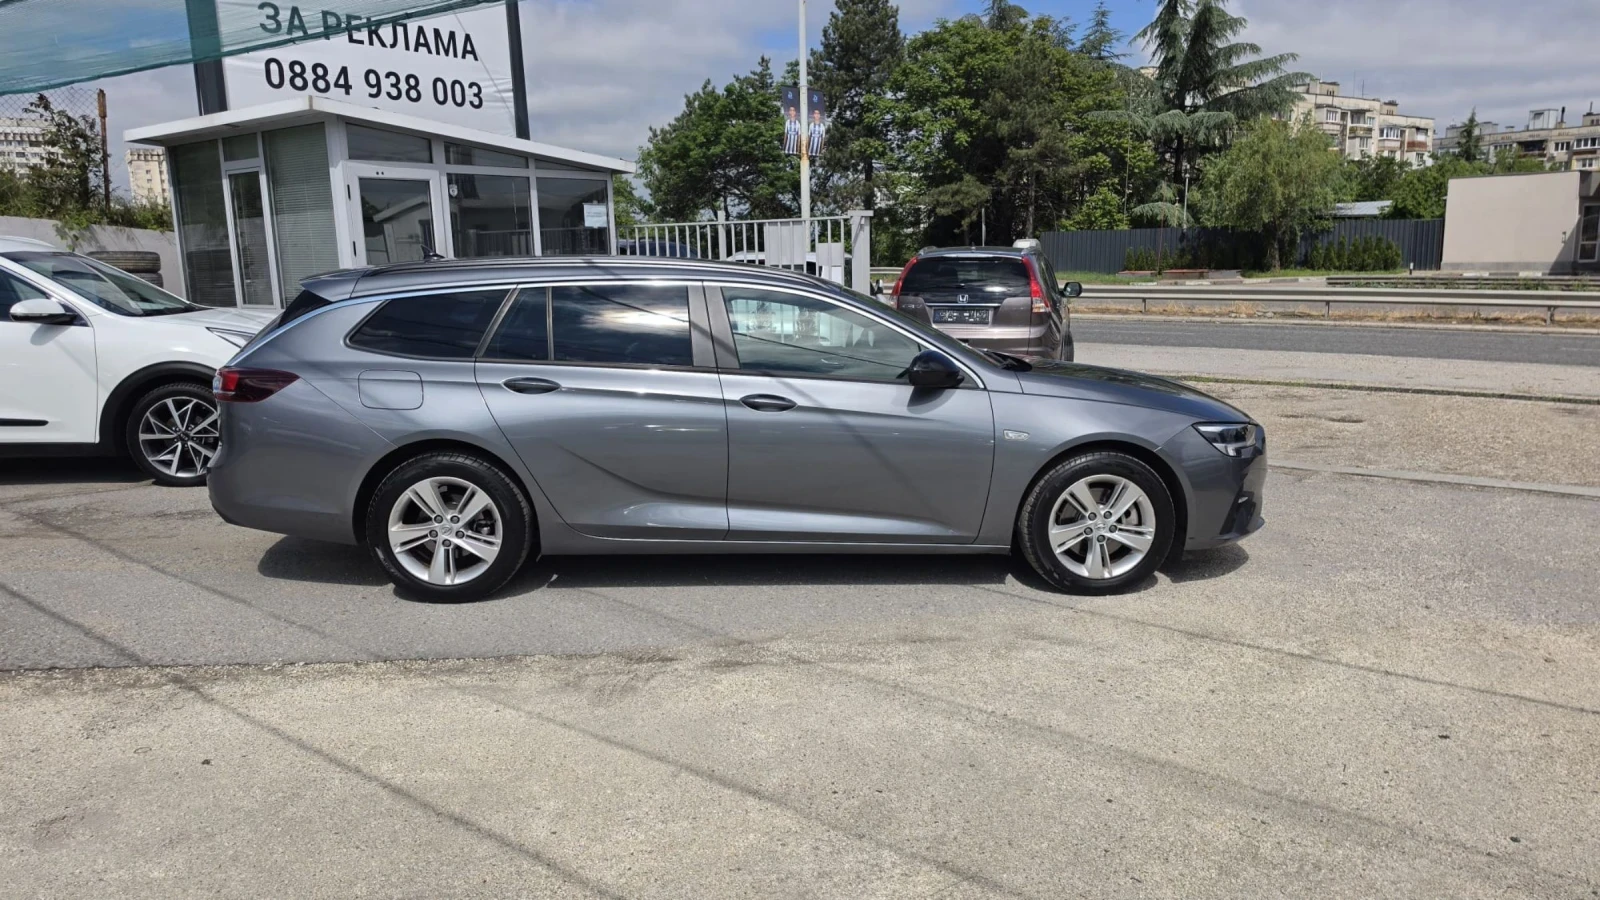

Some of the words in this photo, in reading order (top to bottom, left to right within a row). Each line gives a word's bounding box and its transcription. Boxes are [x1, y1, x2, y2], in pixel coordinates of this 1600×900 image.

[257, 2, 309, 36] ЗА
[321, 10, 479, 61] РЕКЛАМА
[264, 57, 352, 95] 0884
[364, 69, 422, 103] 938
[432, 77, 483, 109] 003
